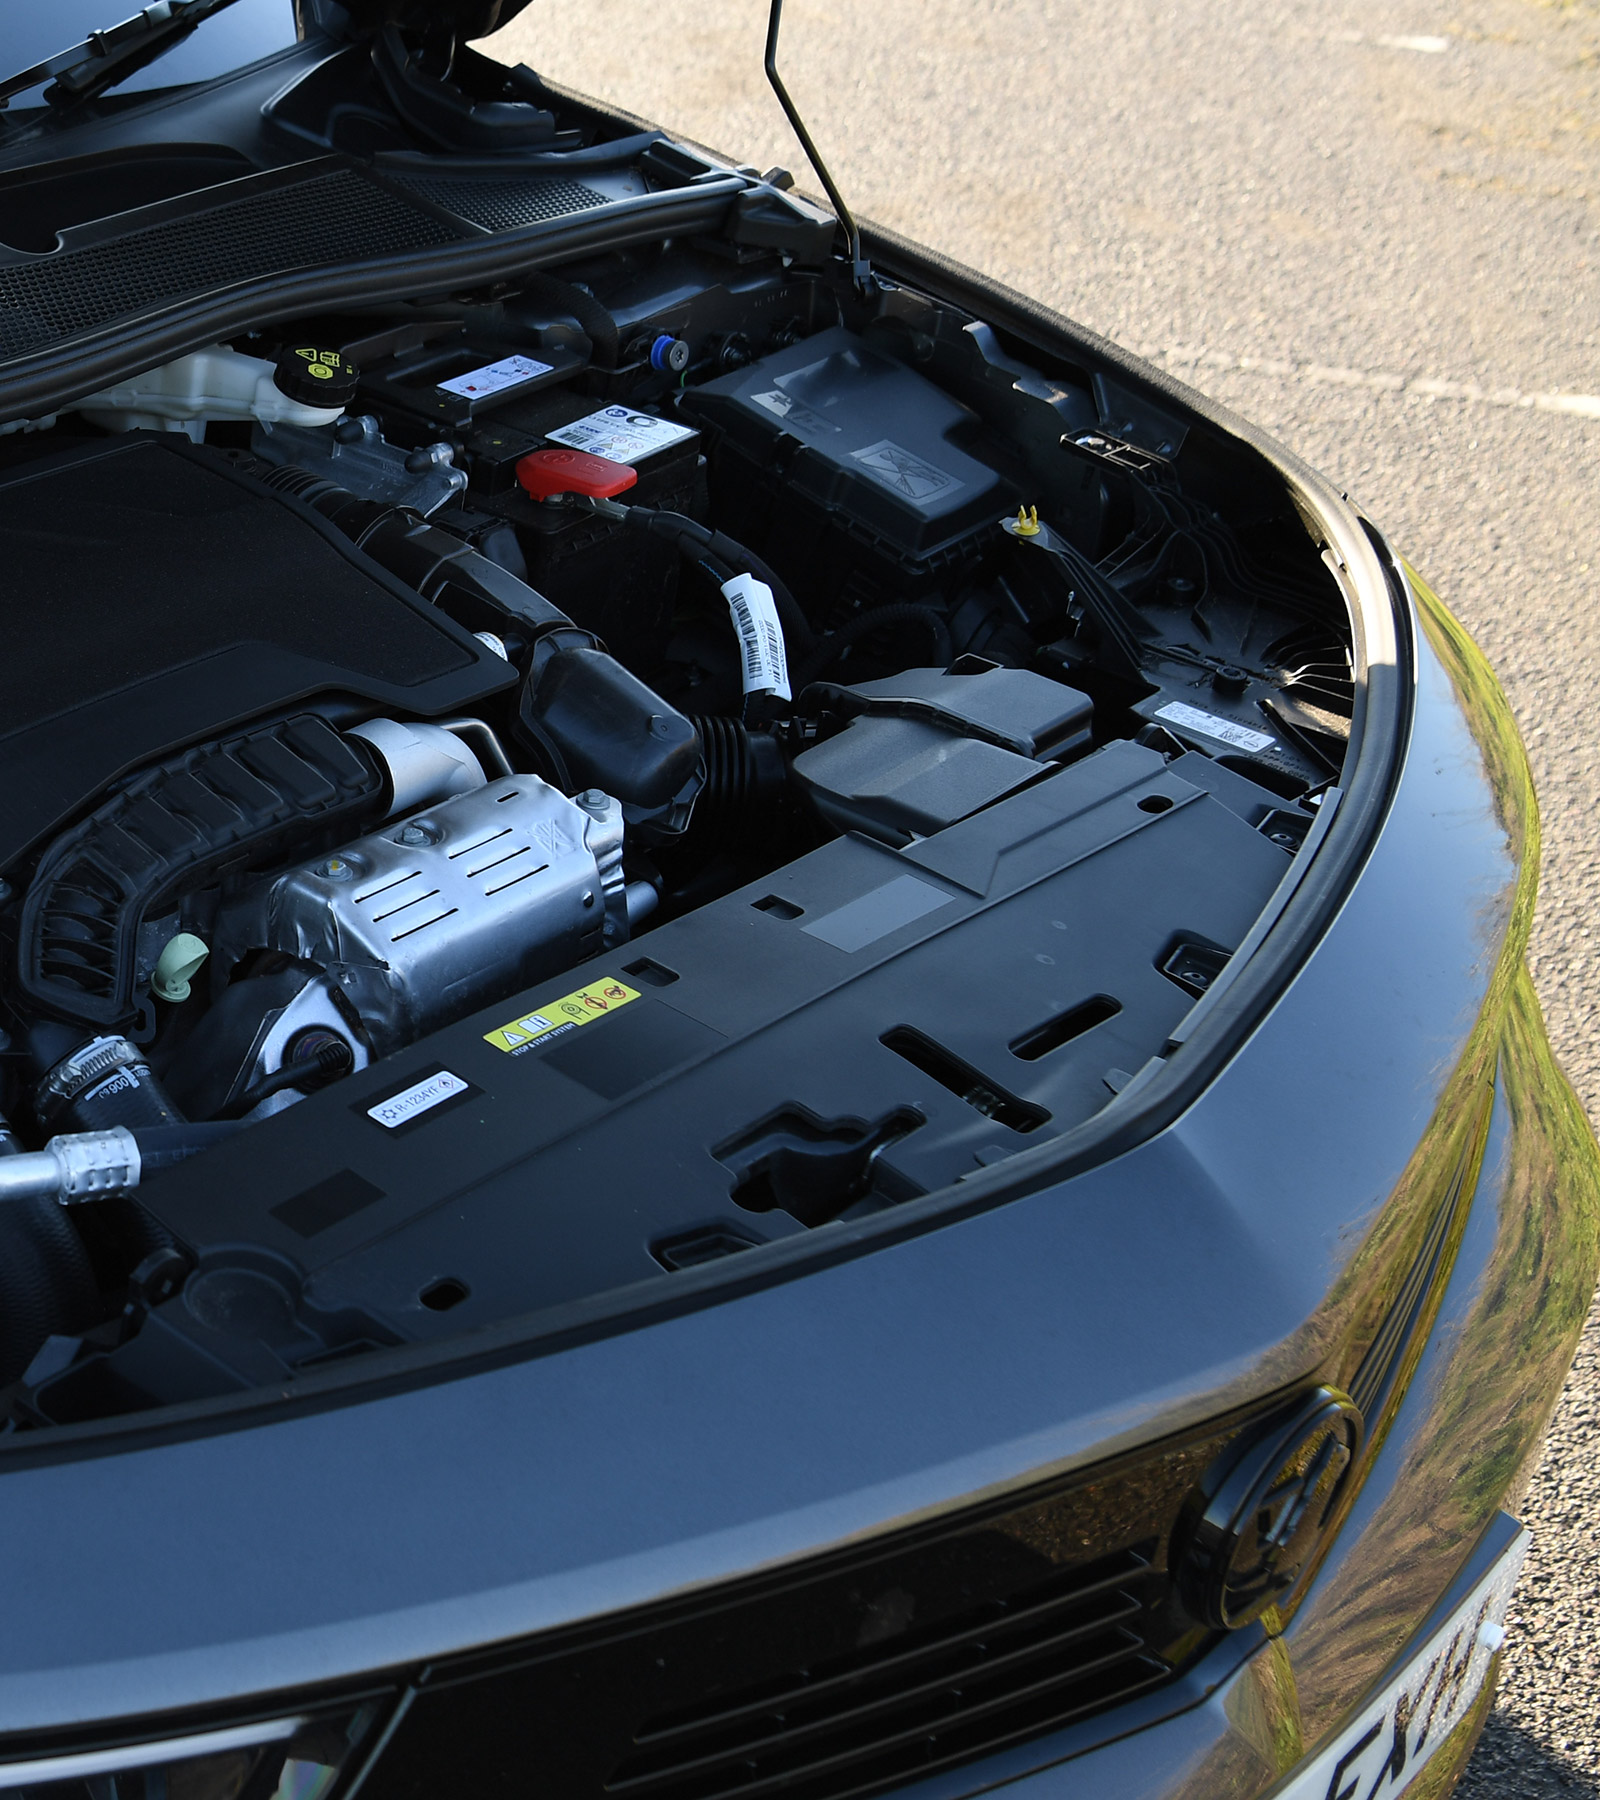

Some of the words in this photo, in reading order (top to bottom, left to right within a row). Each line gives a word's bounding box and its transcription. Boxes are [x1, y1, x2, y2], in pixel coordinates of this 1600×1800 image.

[511, 1044, 529, 1057] STOP
[533, 1032, 553, 1046] START
[551, 1022, 577, 1037] SYSTEM
[394, 1085, 439, 1113] R-1234YF
